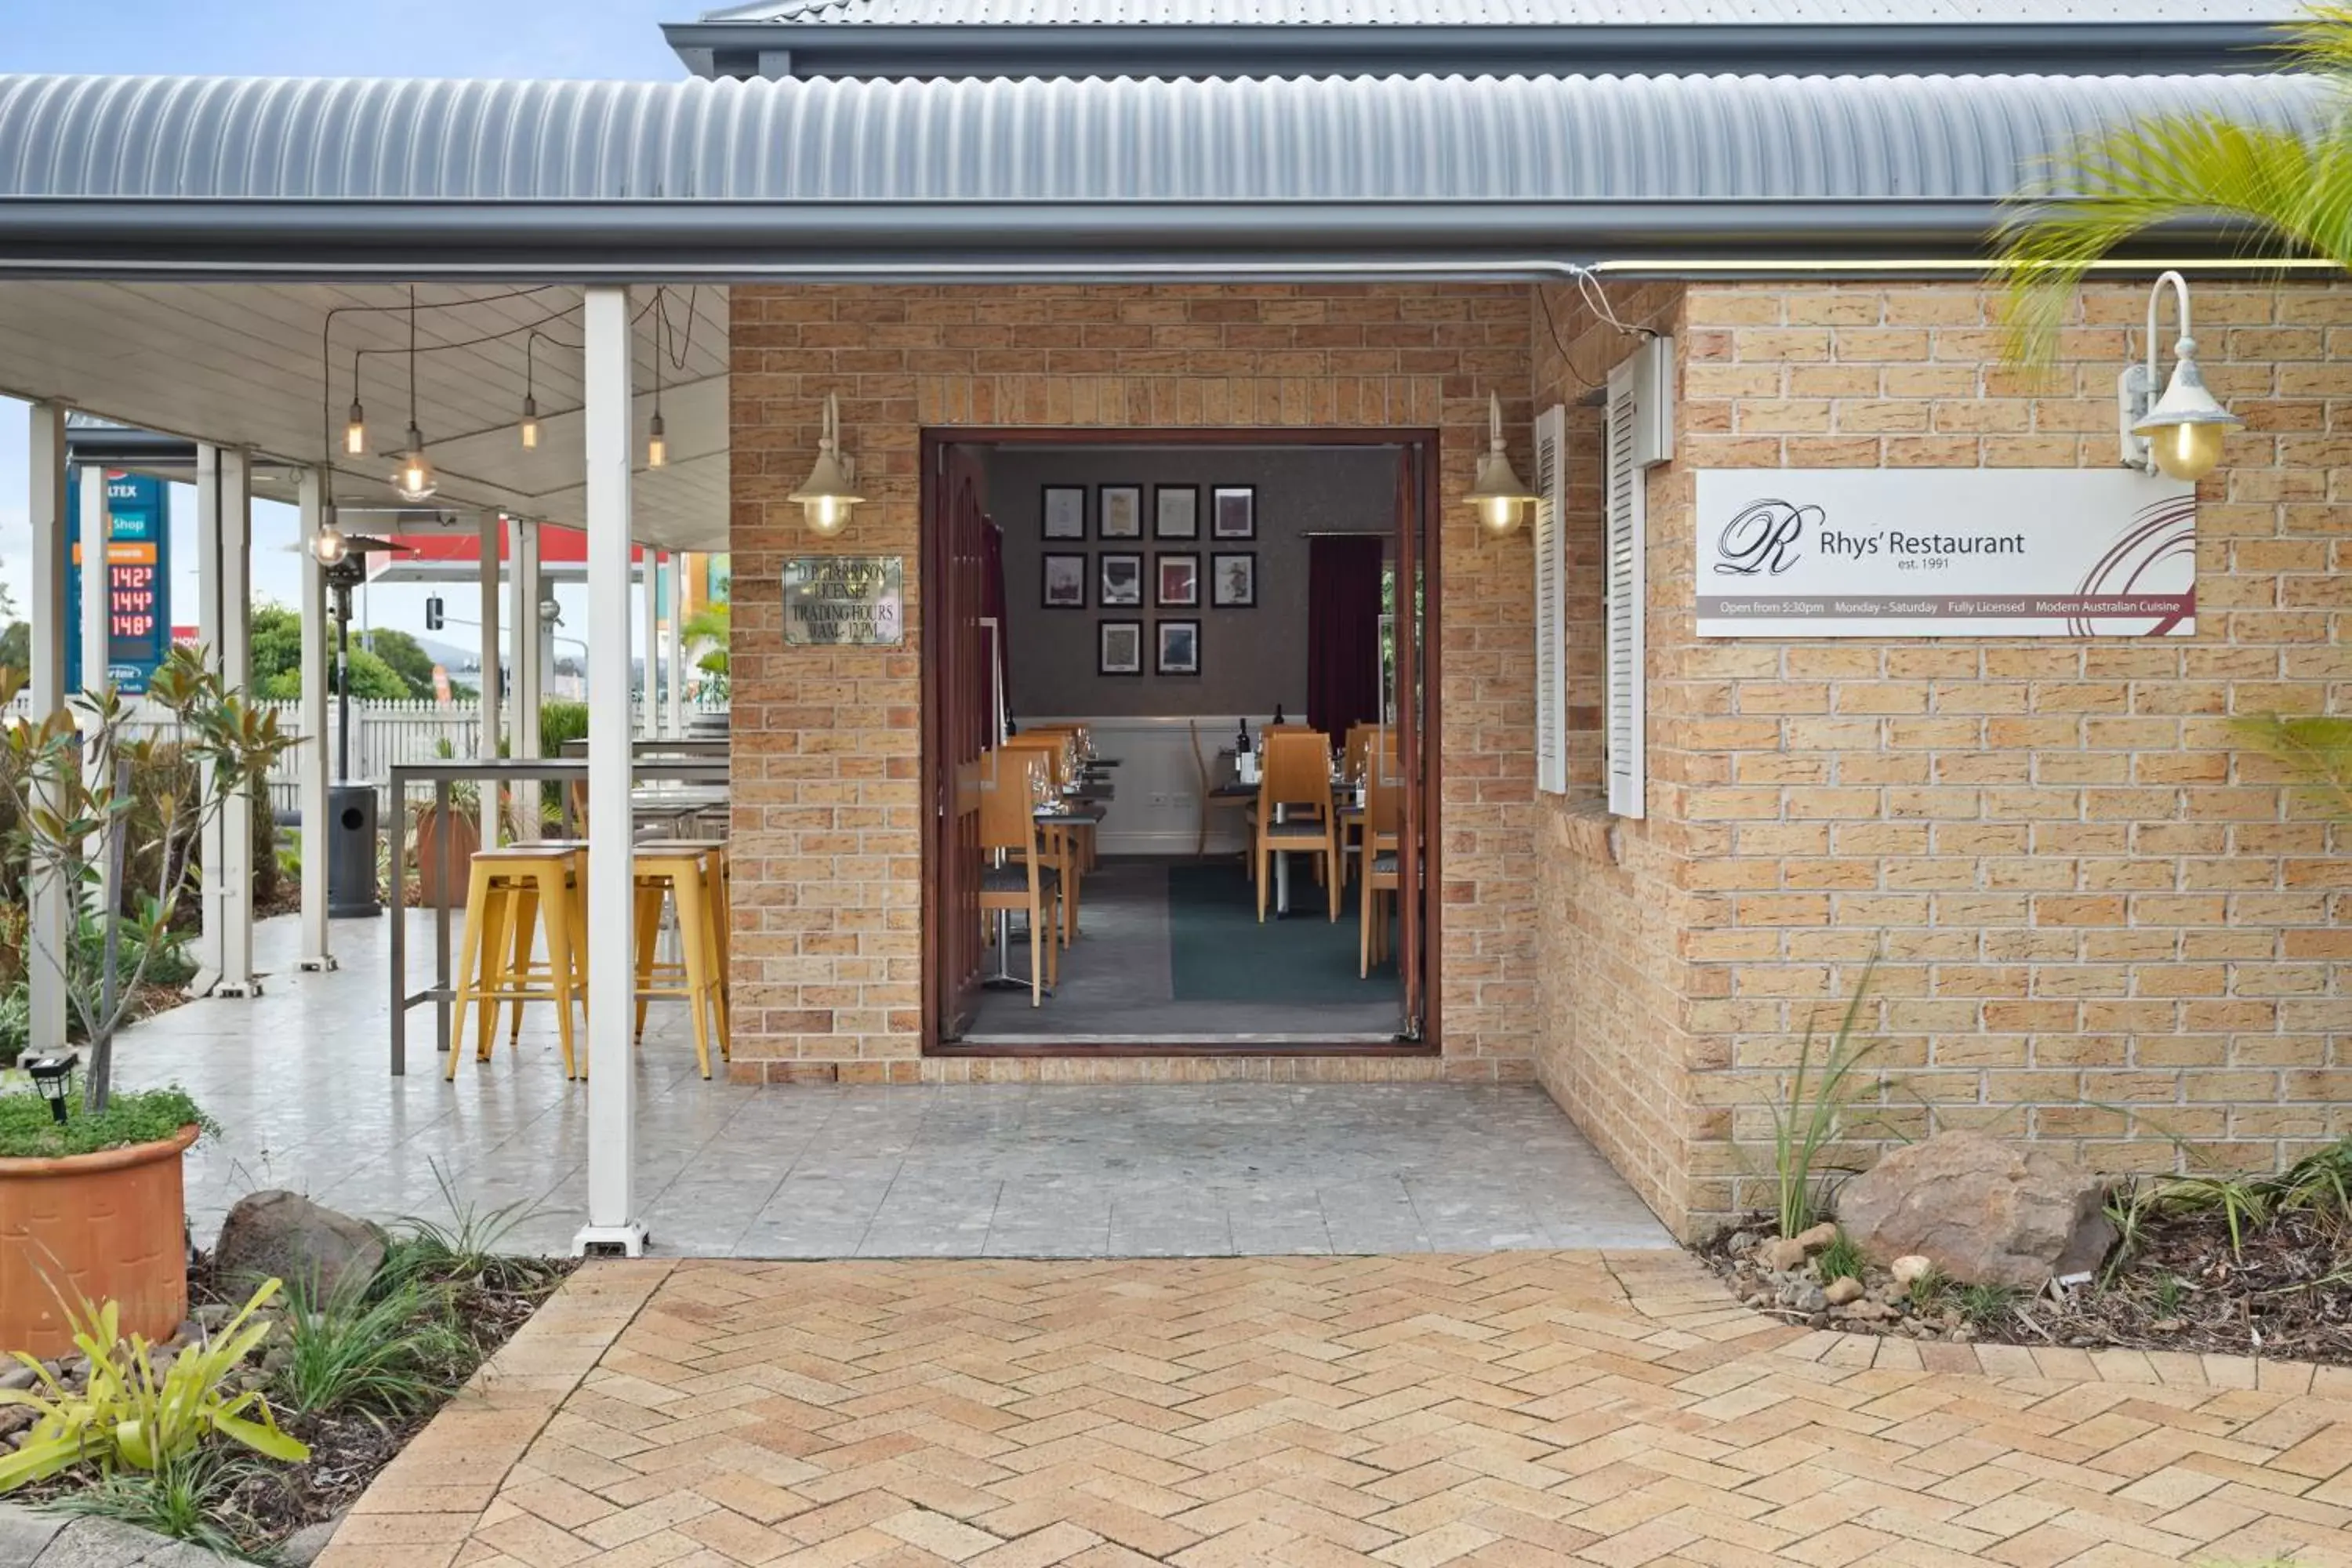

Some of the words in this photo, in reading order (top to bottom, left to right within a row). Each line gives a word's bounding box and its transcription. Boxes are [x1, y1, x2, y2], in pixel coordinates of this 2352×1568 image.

[113, 517, 144, 533] Shop
[1889, 531, 2026, 554] Restaurant
[1897, 558, 1918, 570] est.
[1922, 557, 1949, 569] 1991
[822, 564, 887, 581] HARRISON
[793, 604, 850, 622] TRADING
[851, 604, 894, 622] HOURS
[1719, 601, 1751, 614] Open
[1753, 601, 1780, 612] from
[1783, 601, 1824, 615] 5:30pm
[1835, 601, 1880, 615] Monday
[1889, 601, 1938, 615] Saturday
[1948, 601, 1976, 615] Fully
[1976, 601, 2025, 613] Licensed
[2035, 601, 2081, 612] Modern
[2082, 601, 2136, 612] Australian
[2139, 601, 2180, 612] Cuisine
